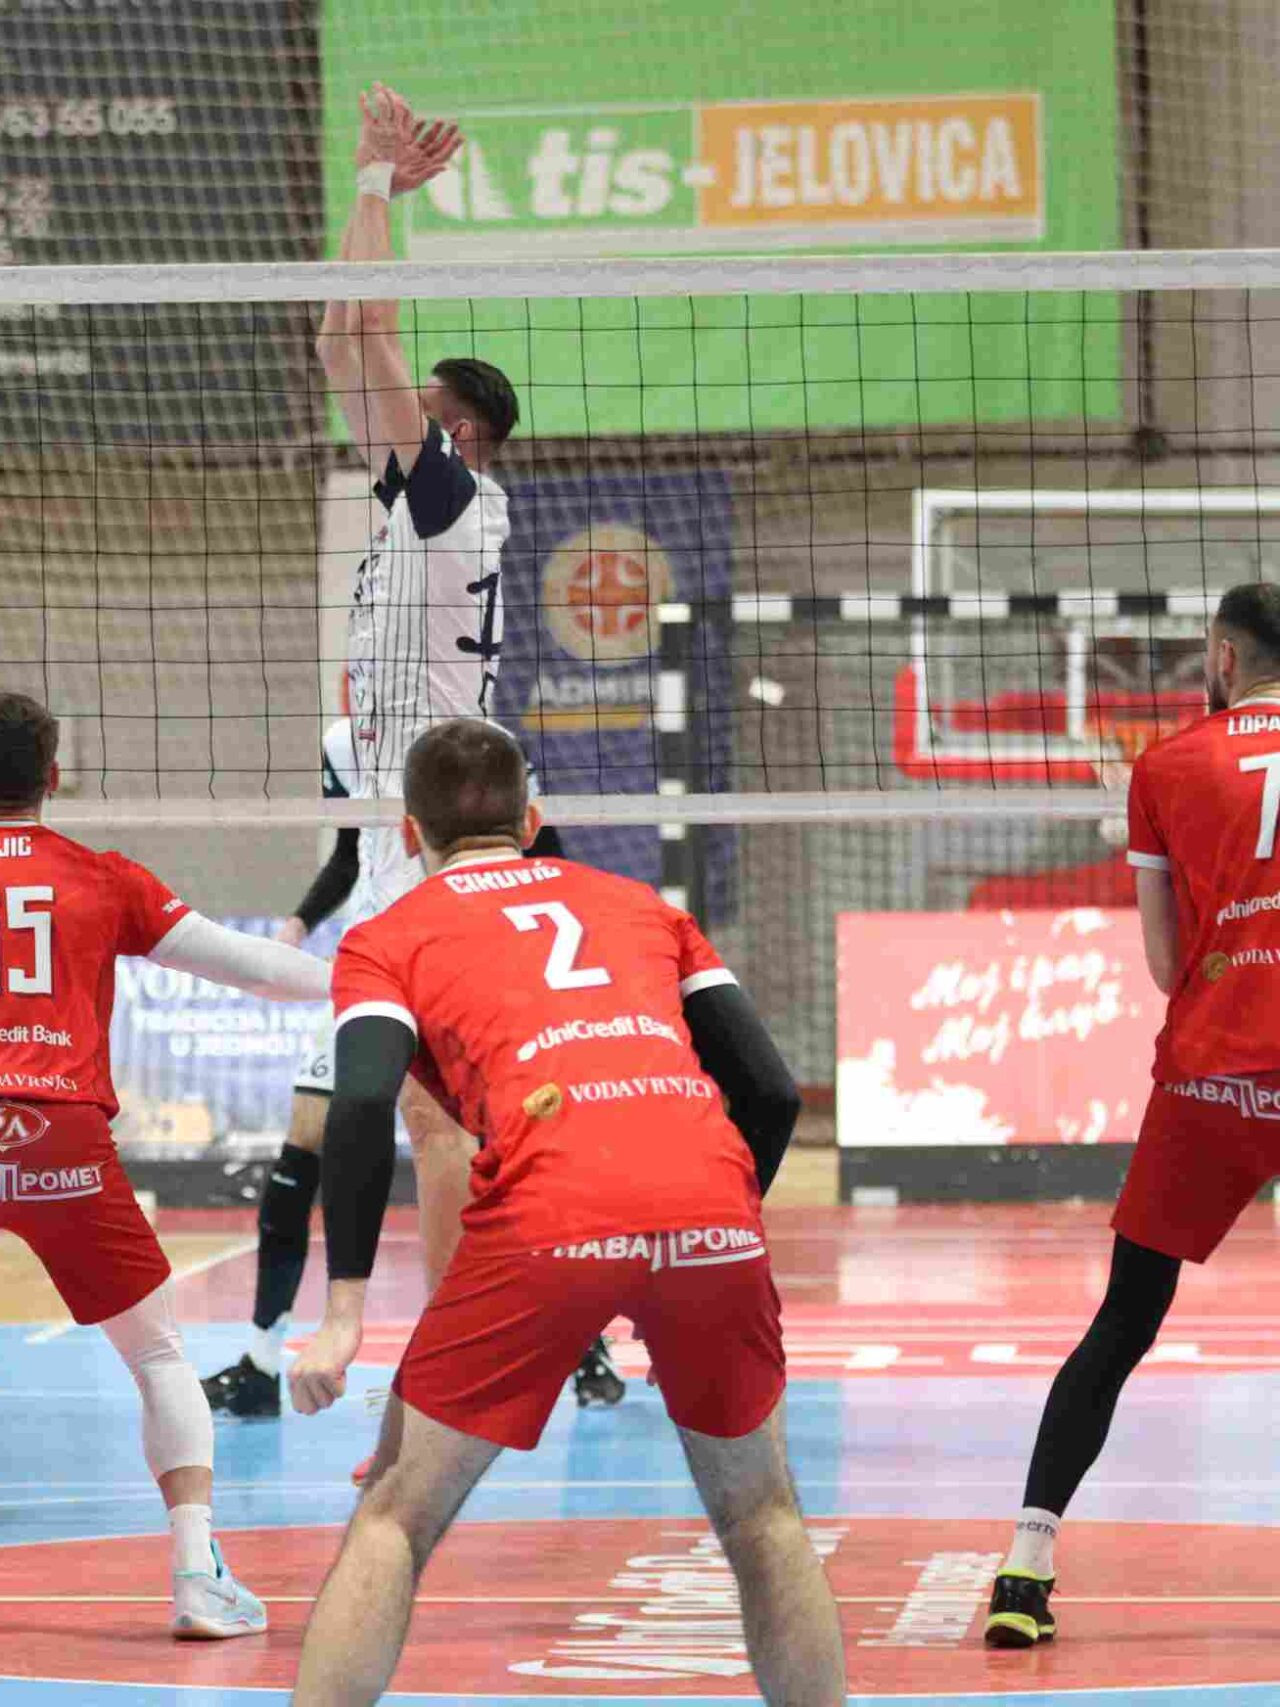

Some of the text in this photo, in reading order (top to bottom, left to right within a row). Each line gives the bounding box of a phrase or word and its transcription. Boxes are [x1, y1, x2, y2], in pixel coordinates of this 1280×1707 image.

[501, 900, 612, 990] 2
[32, 1024, 72, 1047] Bank
[537, 1015, 634, 1050] UniCredit
